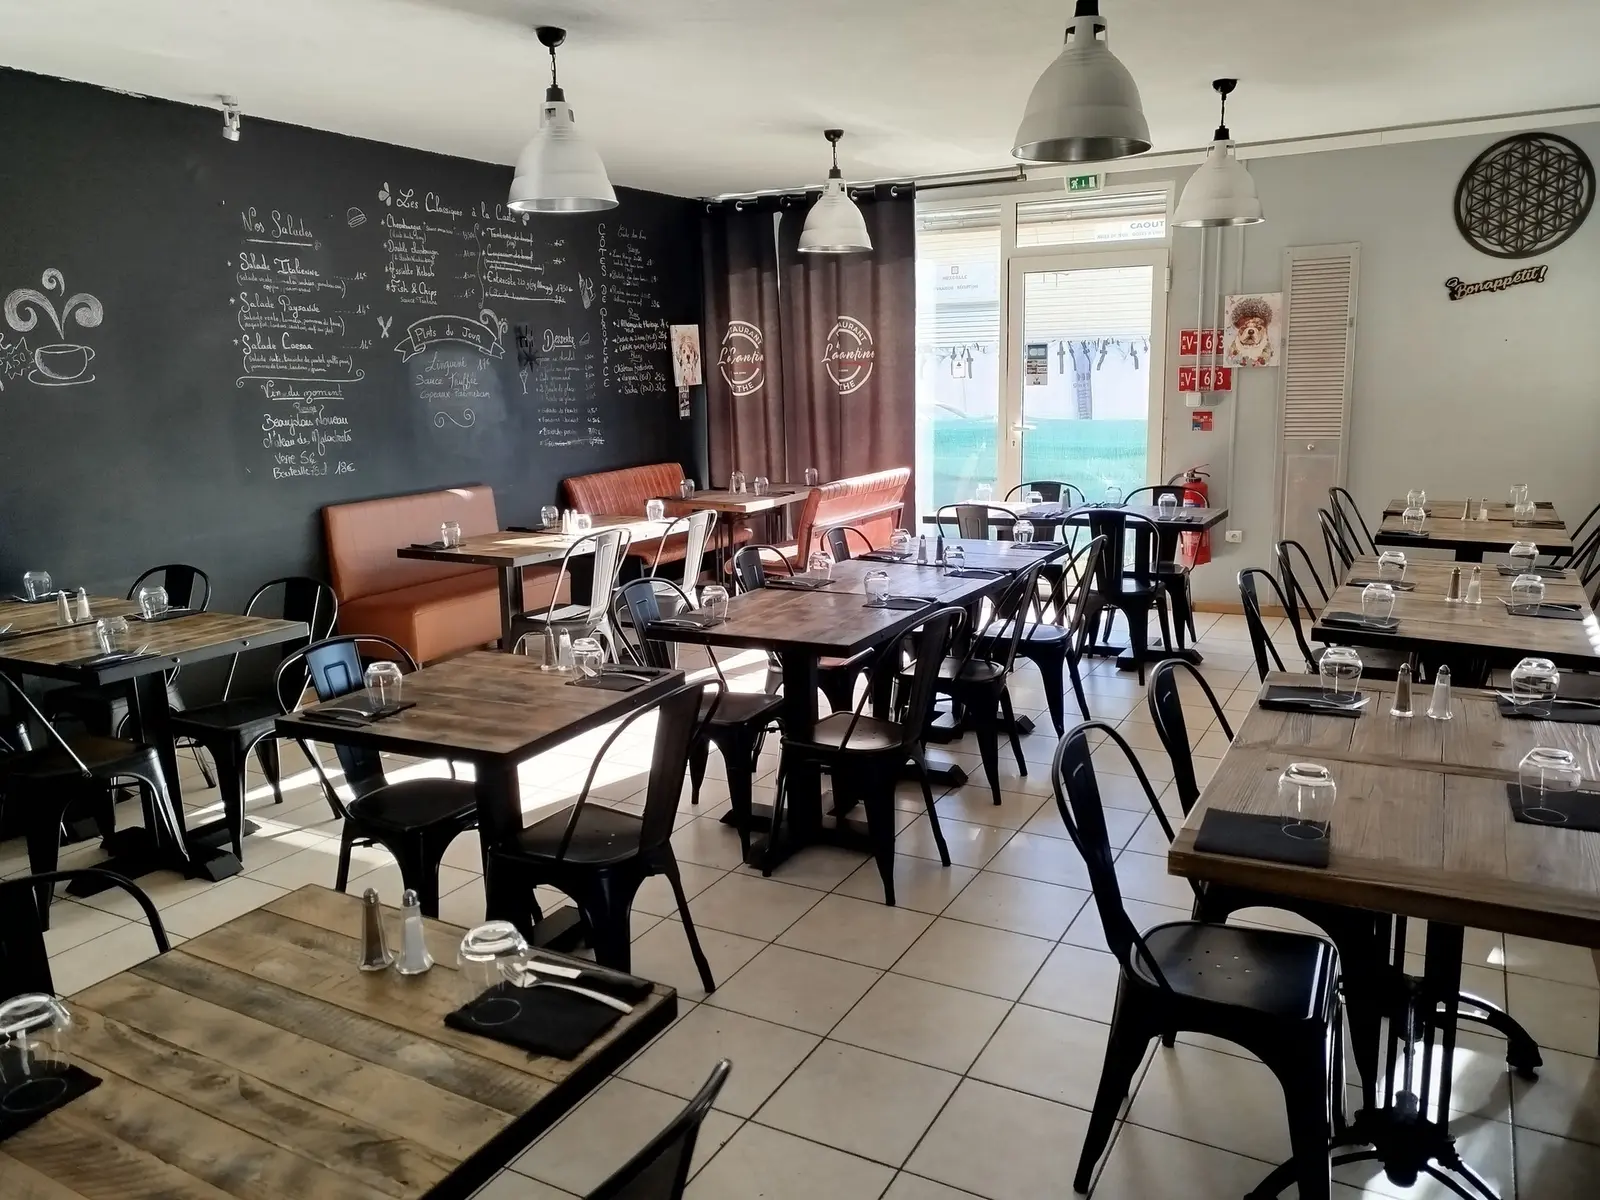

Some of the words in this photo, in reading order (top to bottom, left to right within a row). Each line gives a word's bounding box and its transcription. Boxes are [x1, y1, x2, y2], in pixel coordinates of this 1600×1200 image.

[396, 188, 419, 209] Les
[425, 191, 463, 221] Classiques
[481, 201, 491, 219] la
[241, 207, 265, 233] Nos
[271, 209, 313, 238] Salades
[1130, 220, 1165, 229] CAOUT
[240, 252, 270, 271] Salade
[274, 258, 320, 277] Italienne
[391, 279, 409, 292] Fish
[411, 282, 418, 293] &
[419, 281, 437, 300] Chips
[240, 292, 275, 313] Salade
[278, 294, 321, 319] Paysanne
[242, 333, 276, 354] Salade
[282, 331, 313, 349] Caesar
[414, 325, 436, 341] Plats
[446, 324, 454, 336] du
[462, 326, 481, 342] Jour
[600, 307, 611, 388] PROVENCE
[261, 380, 280, 398] Vin
[287, 384, 299, 397] du
[416, 374, 443, 386] Sauce
[275, 452, 296, 465] Verre
[335, 461, 355, 475] 18€
